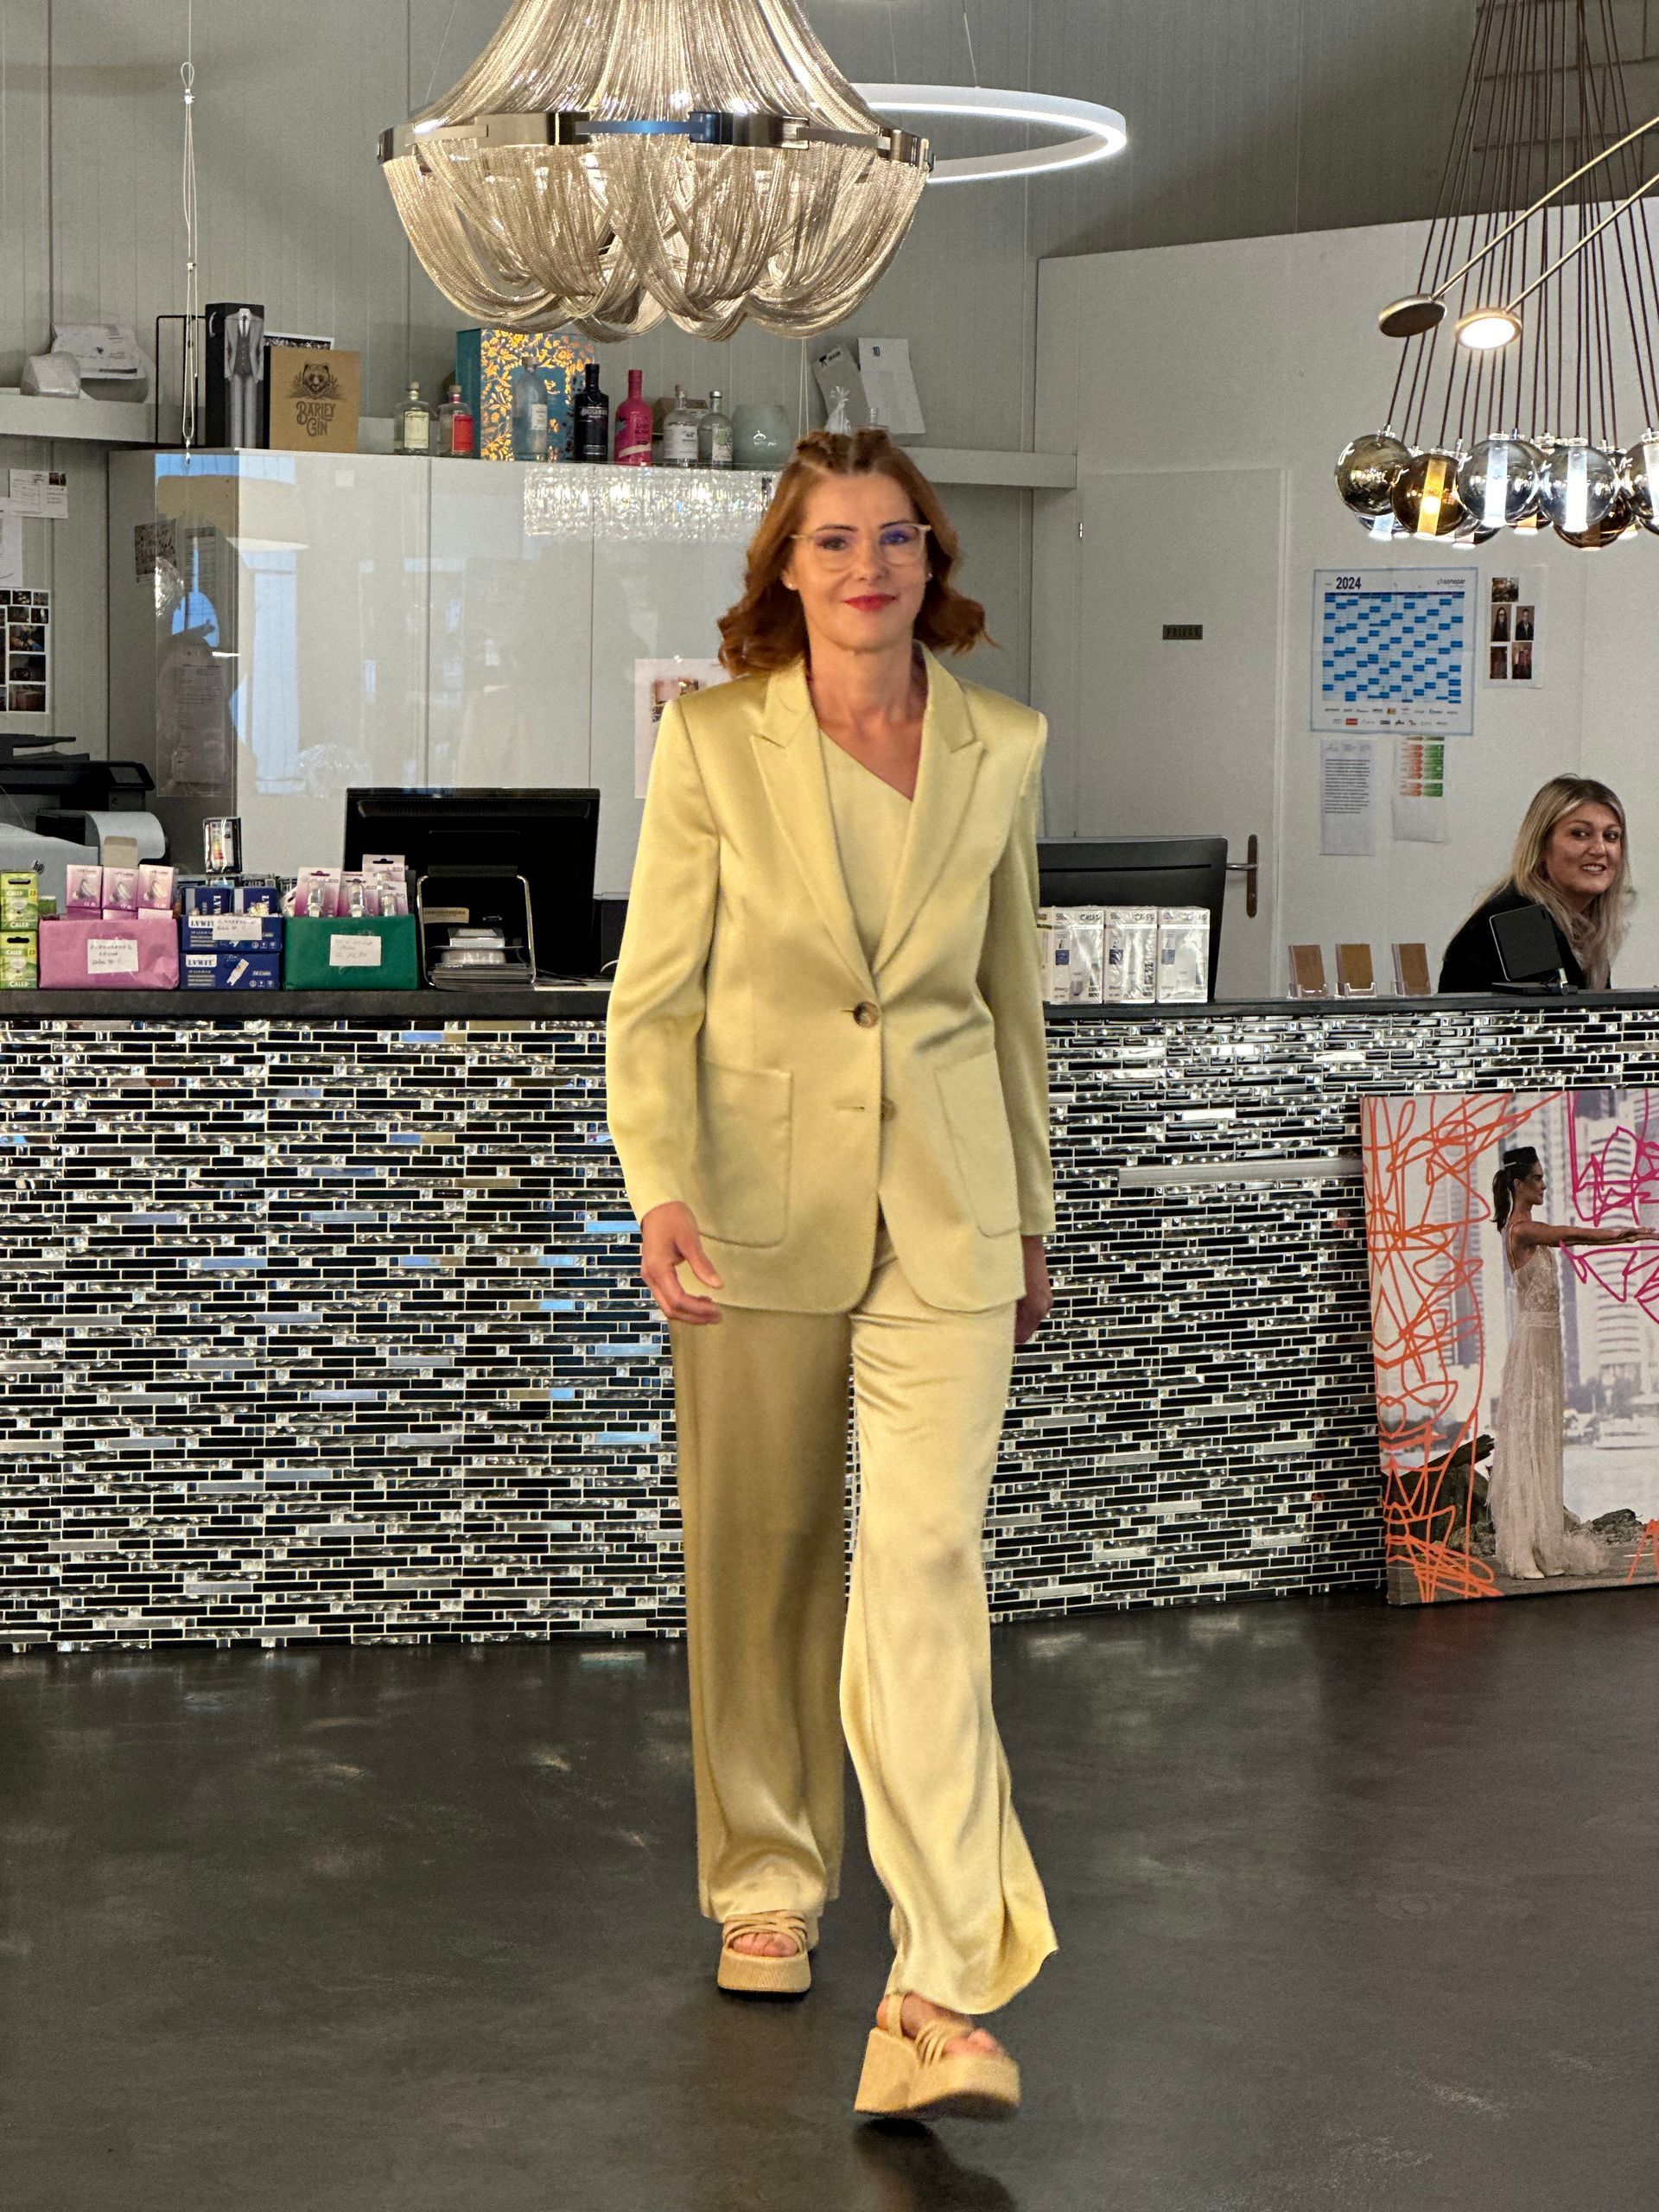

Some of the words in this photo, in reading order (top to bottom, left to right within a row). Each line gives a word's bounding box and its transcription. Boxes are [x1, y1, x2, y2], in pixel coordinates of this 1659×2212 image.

[873, 346, 880, 357] 10
[296, 401, 336, 425] BARLEY
[307, 417, 327, 436] GIN
[1336, 576, 1362, 589] 2024
[34, 860, 44, 874] hp
